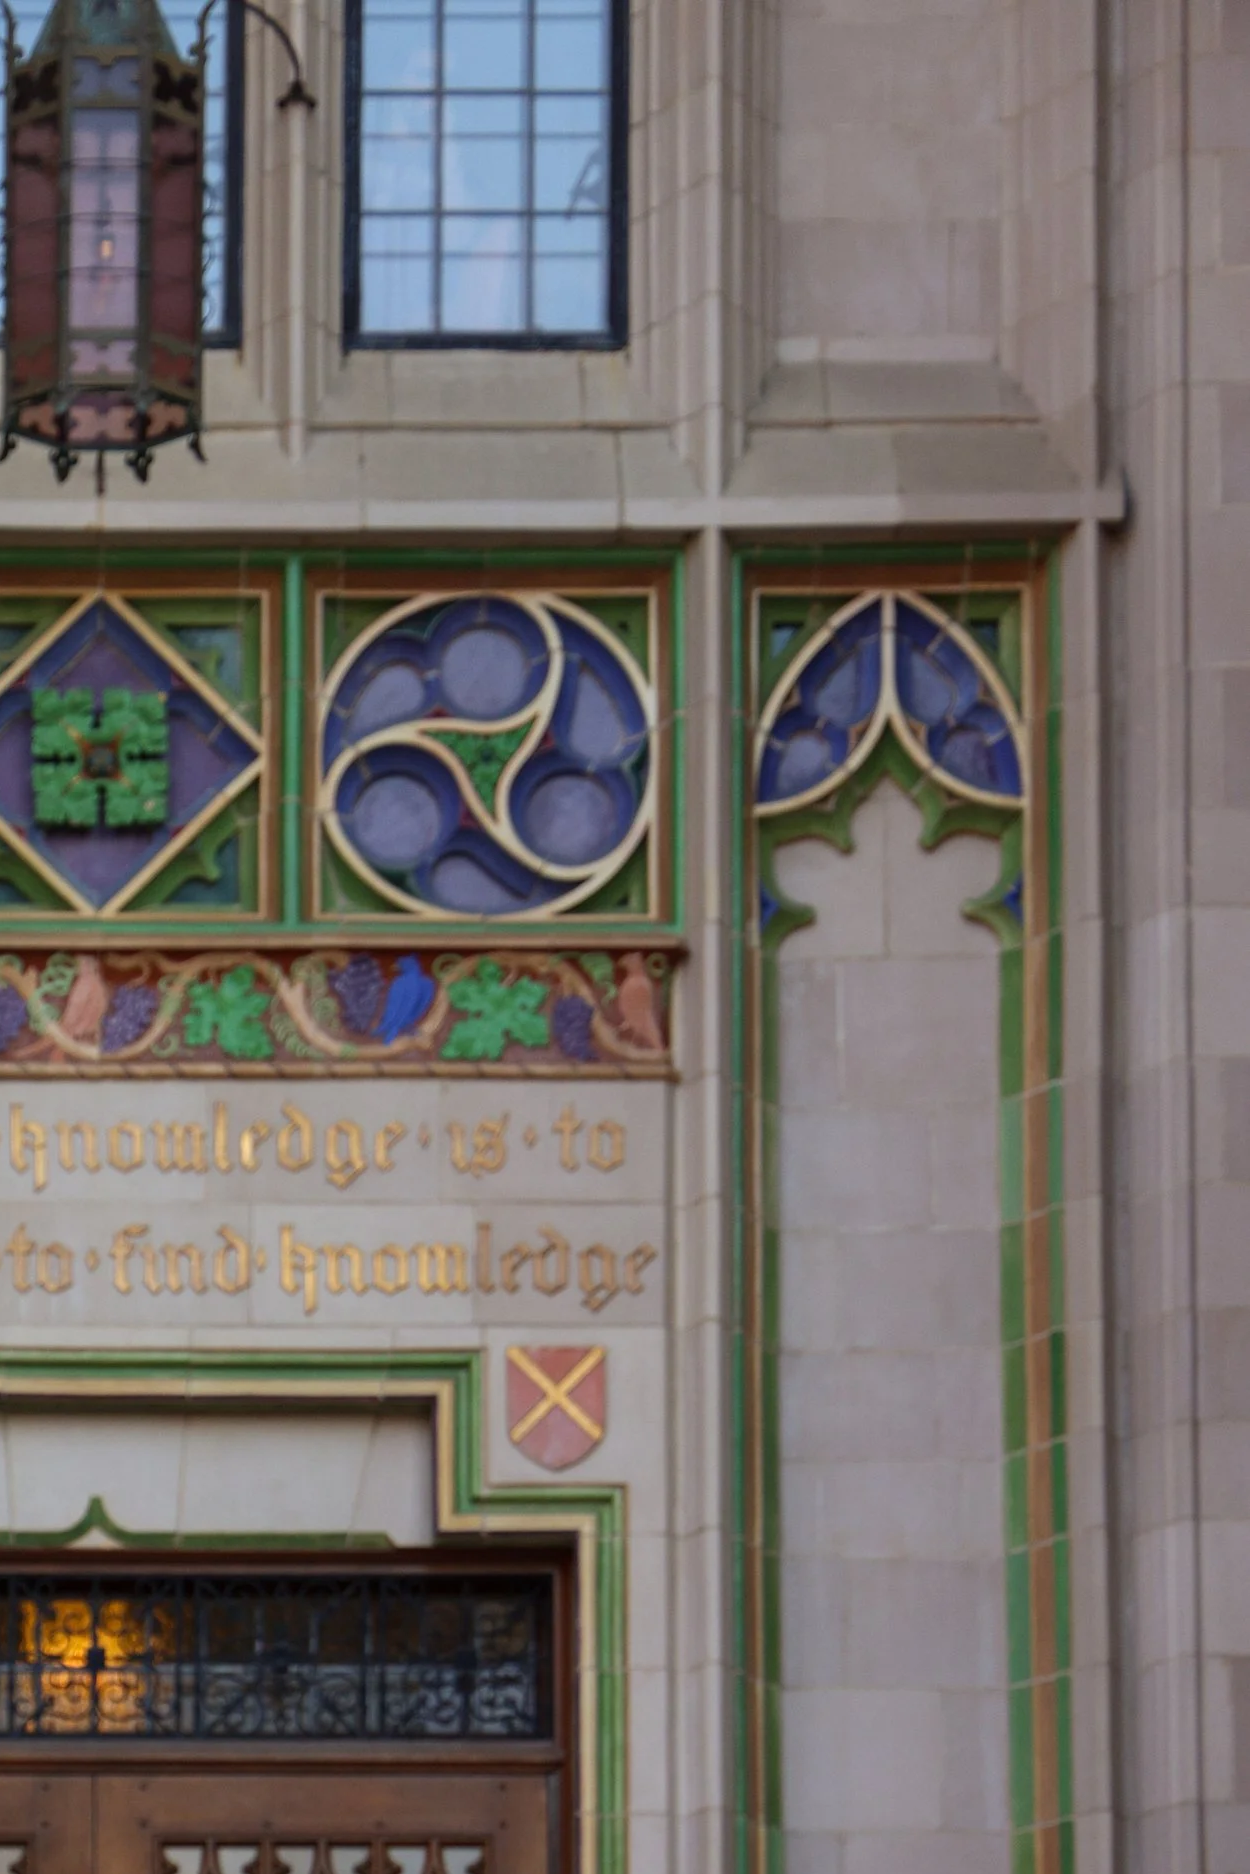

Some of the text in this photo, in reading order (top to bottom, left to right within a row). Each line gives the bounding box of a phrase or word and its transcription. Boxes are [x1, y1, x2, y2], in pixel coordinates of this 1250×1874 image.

[9, 1100, 405, 1190] knowledge
[448, 1111, 509, 1178] is
[554, 1105, 626, 1171] to
[7, 1223, 74, 1294] to
[111, 1224, 252, 1295] find
[280, 1222, 656, 1315] knowledge
